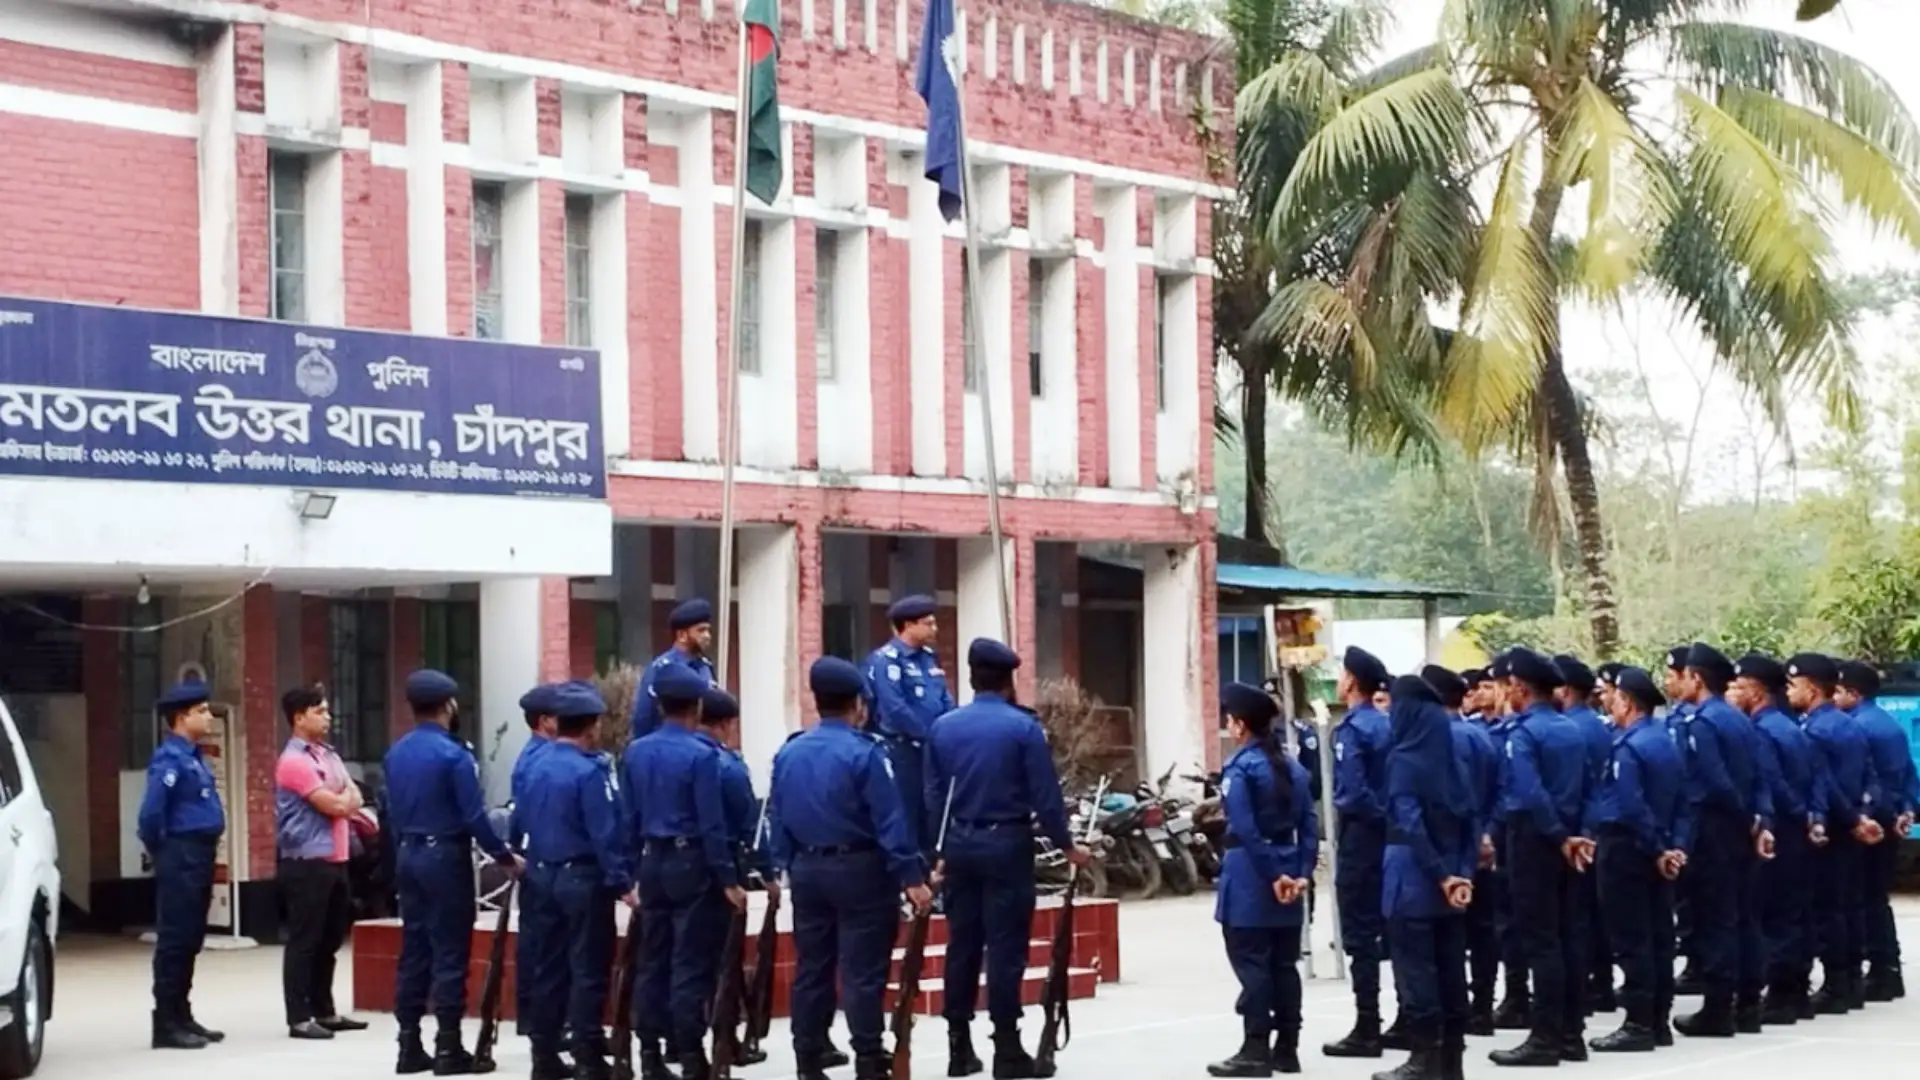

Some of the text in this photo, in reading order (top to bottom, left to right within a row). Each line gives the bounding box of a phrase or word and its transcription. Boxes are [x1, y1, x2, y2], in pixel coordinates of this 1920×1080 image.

[150, 344, 430, 391] বাংলাদেশ পুলিশ
[0, 384, 590, 468] মতলব উত্তর থানা, চাঁদপুর
